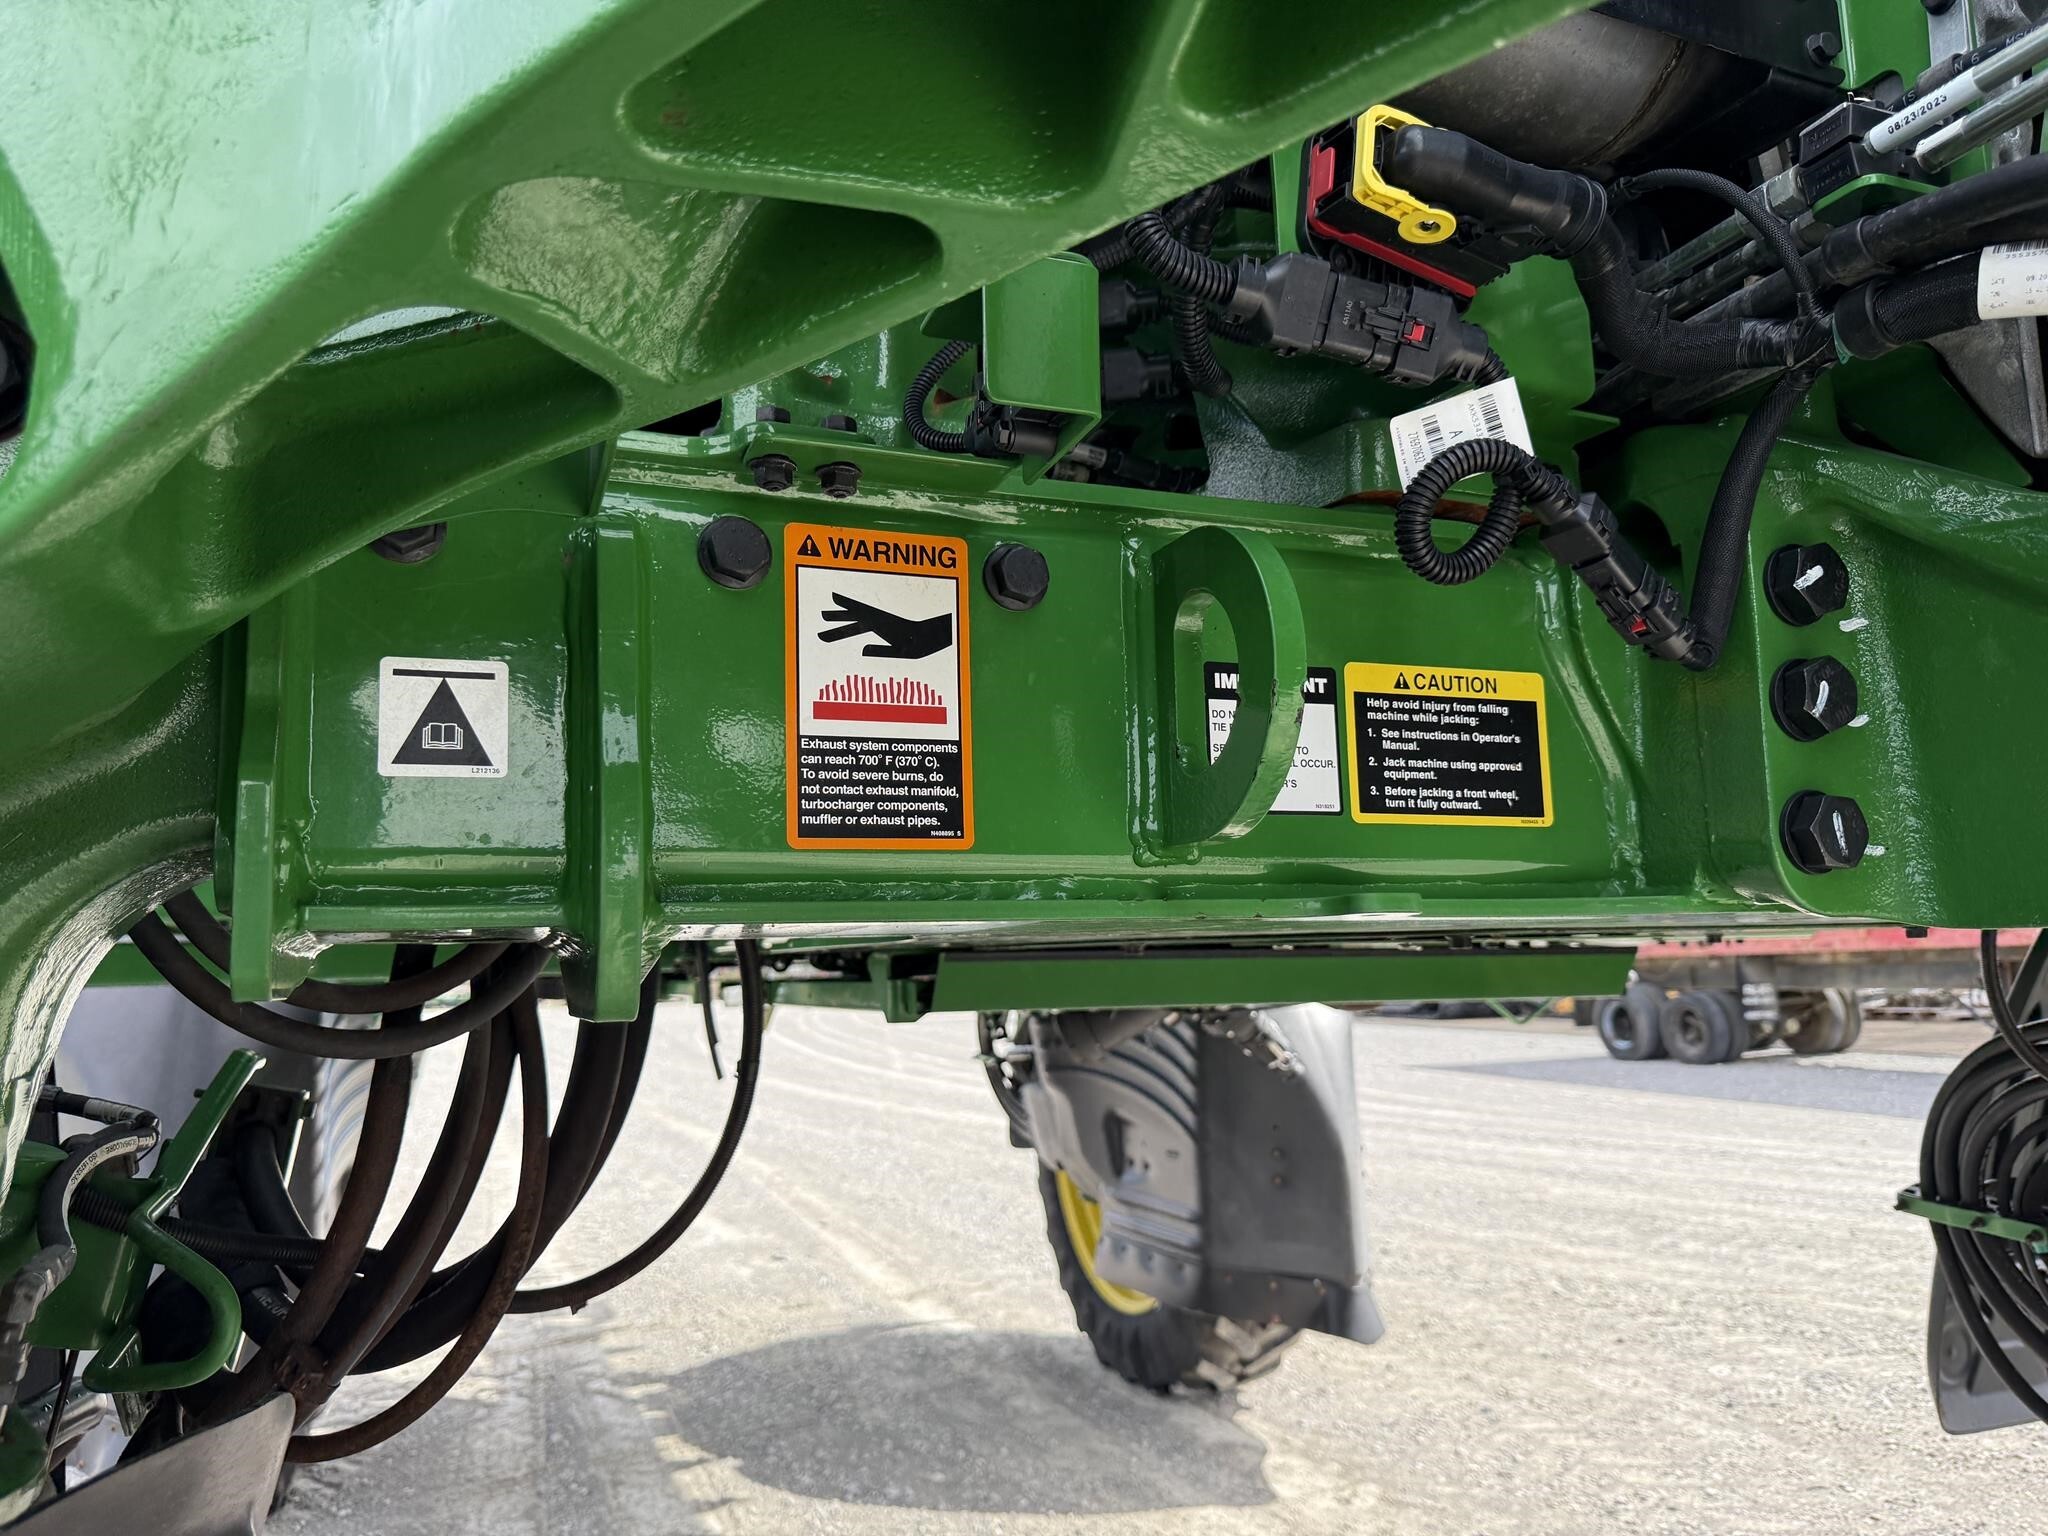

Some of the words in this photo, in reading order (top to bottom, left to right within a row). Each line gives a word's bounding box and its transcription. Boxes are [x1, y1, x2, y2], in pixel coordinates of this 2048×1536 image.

[1449, 430, 1464, 439] A
[828, 536, 957, 568] WARNING
[1414, 672, 1497, 694] CAUTION
[1366, 698, 1390, 710] Help
[1392, 700, 1420, 710] avoid
[1422, 701, 1450, 713] injury
[1452, 702, 1476, 712] from
[1478, 704, 1508, 716] falling
[1212, 710, 1226, 718] DO
[1368, 711, 1410, 721] machine
[1412, 712, 1438, 722] while
[1440, 714, 1480, 726] jacking:
[1212, 723, 1226, 732] TIE
[1368, 728, 1376, 738] 1.
[1382, 728, 1400, 738] See
[1402, 729, 1459, 740] instructions
[1460, 732, 1470, 740] in
[1472, 732, 1520, 744] Operator's
[801, 738, 848, 750] Exhaust
[850, 741, 889, 752] system
[892, 742, 958, 754] components
[1382, 740, 1420, 750] Manual.
[801, 755, 822, 764] can
[824, 755, 856, 764] reach
[858, 754, 882, 766] 700°
[886, 756, 892, 766] F
[896, 755, 922, 768] (370°
[925, 757, 940, 769] C).
[1300, 760, 1336, 768] OCCUR.
[1368, 757, 1378, 766] 2.
[1383, 758, 1406, 767] Jack
[1408, 758, 1448, 768] machine
[1450, 760, 1477, 772] using
[1478, 762, 1522, 772] approved
[801, 768, 816, 778] To
[818, 769, 849, 780] avoid
[852, 772, 889, 780] severe
[892, 771, 927, 782] burns,
[930, 772, 944, 782] do
[1384, 770, 1437, 780] equipment.
[801, 785, 820, 794] not
[822, 785, 864, 795] contact
[866, 785, 908, 796] exhaust
[911, 786, 959, 798] manifold,
[1370, 786, 1380, 795] 3.
[1385, 786, 1417, 796] Before
[1419, 787, 1454, 799] jacking
[1464, 789, 1487, 798] front
[1489, 790, 1519, 800] wheel,
[802, 800, 874, 812] turbocharger
[877, 802, 948, 812] components,
[1386, 798, 1406, 808] turn
[1408, 799, 1415, 808] it
[1417, 799, 1438, 810] fully
[1440, 800, 1482, 810] outward.
[802, 814, 842, 825] muffler
[845, 816, 858, 825] or
[860, 814, 905, 826] exhaust
[908, 815, 940, 827] pipes.
